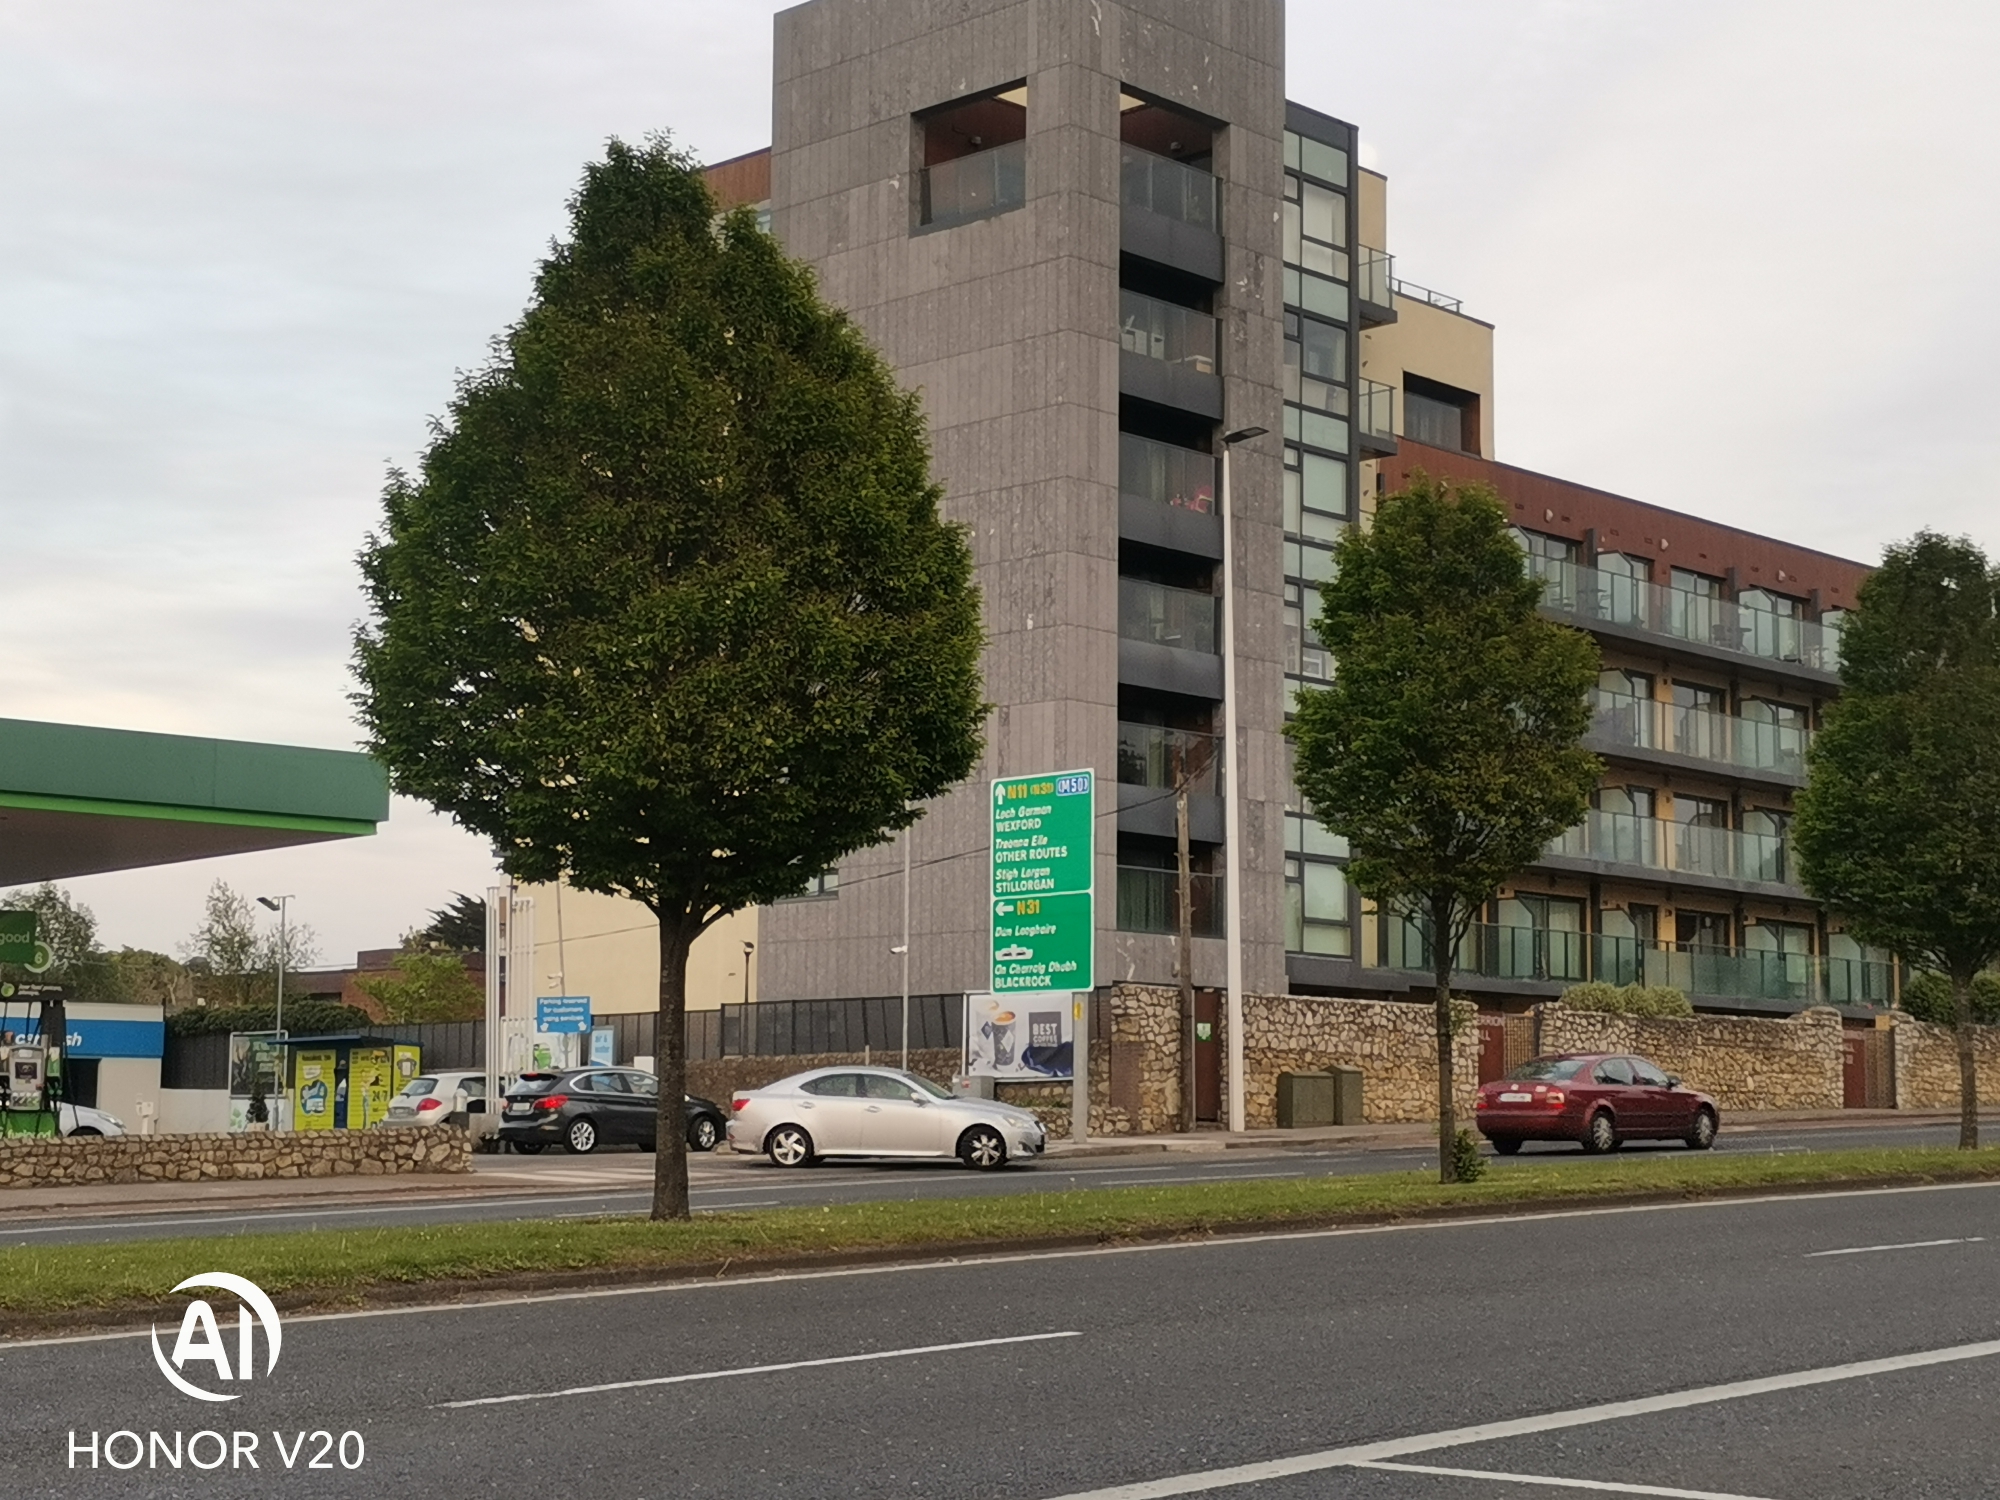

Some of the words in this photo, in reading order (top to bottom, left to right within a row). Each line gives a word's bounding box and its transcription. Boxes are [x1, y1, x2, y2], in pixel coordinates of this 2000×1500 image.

[1058, 777, 1089, 793] (M50)
[995, 818, 1042, 833] WEXFORD
[995, 850, 1027, 864] OTHER
[1029, 845, 1068, 860] ROUTES
[1021, 867, 1051, 879] Lorgan
[995, 878, 1055, 894] STILLORGAN
[1016, 899, 1040, 916] N31
[995, 975, 1052, 989] BLACKROCK
[1032, 1022, 1058, 1036] BEST
